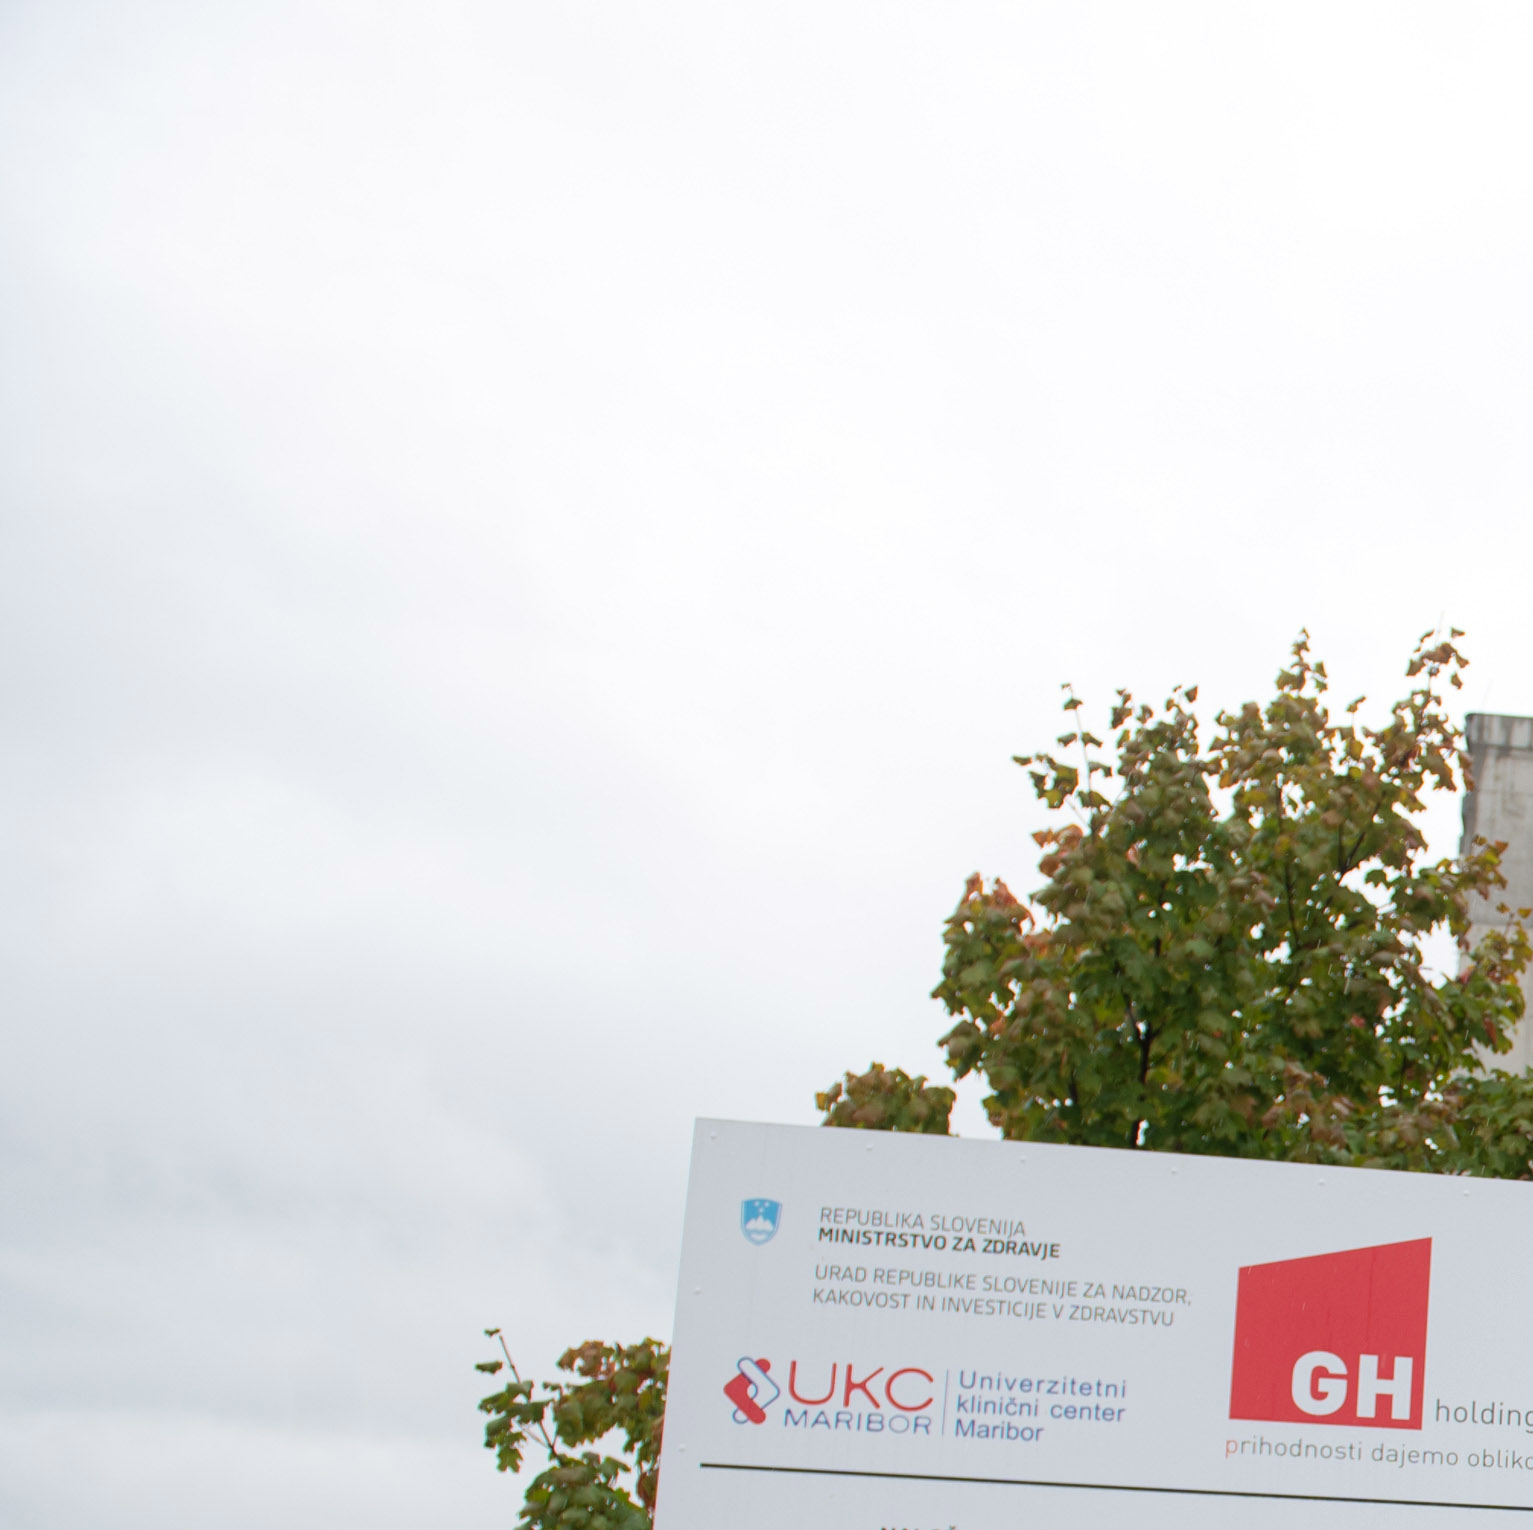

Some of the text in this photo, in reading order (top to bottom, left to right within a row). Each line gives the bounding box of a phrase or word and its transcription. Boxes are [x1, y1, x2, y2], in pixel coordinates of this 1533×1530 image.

[819, 1206, 1025, 1241] REPUBLIKA SLOVENIJA
[817, 1227, 1060, 1260] MINISTRSTVO ZA ZDRAVJE
[813, 1263, 1191, 1306] URAD REPUBLIKE SLOVENIJE ZA NADZOR,
[810, 1287, 1173, 1327] KAKOVOST IN INVESTICIJE V ZDRAVSTVU
[788, 1360, 934, 1412] UKC
[958, 1369, 1125, 1399] Univerzitetni
[1291, 1351, 1413, 1421] GH
[783, 1408, 932, 1435] MARIBOR
[955, 1393, 1125, 1422] klinični center
[954, 1417, 1044, 1441] Maribor
[1225, 1434, 1362, 1461] prihodnosti
[1369, 1442, 1458, 1469] dajemo
